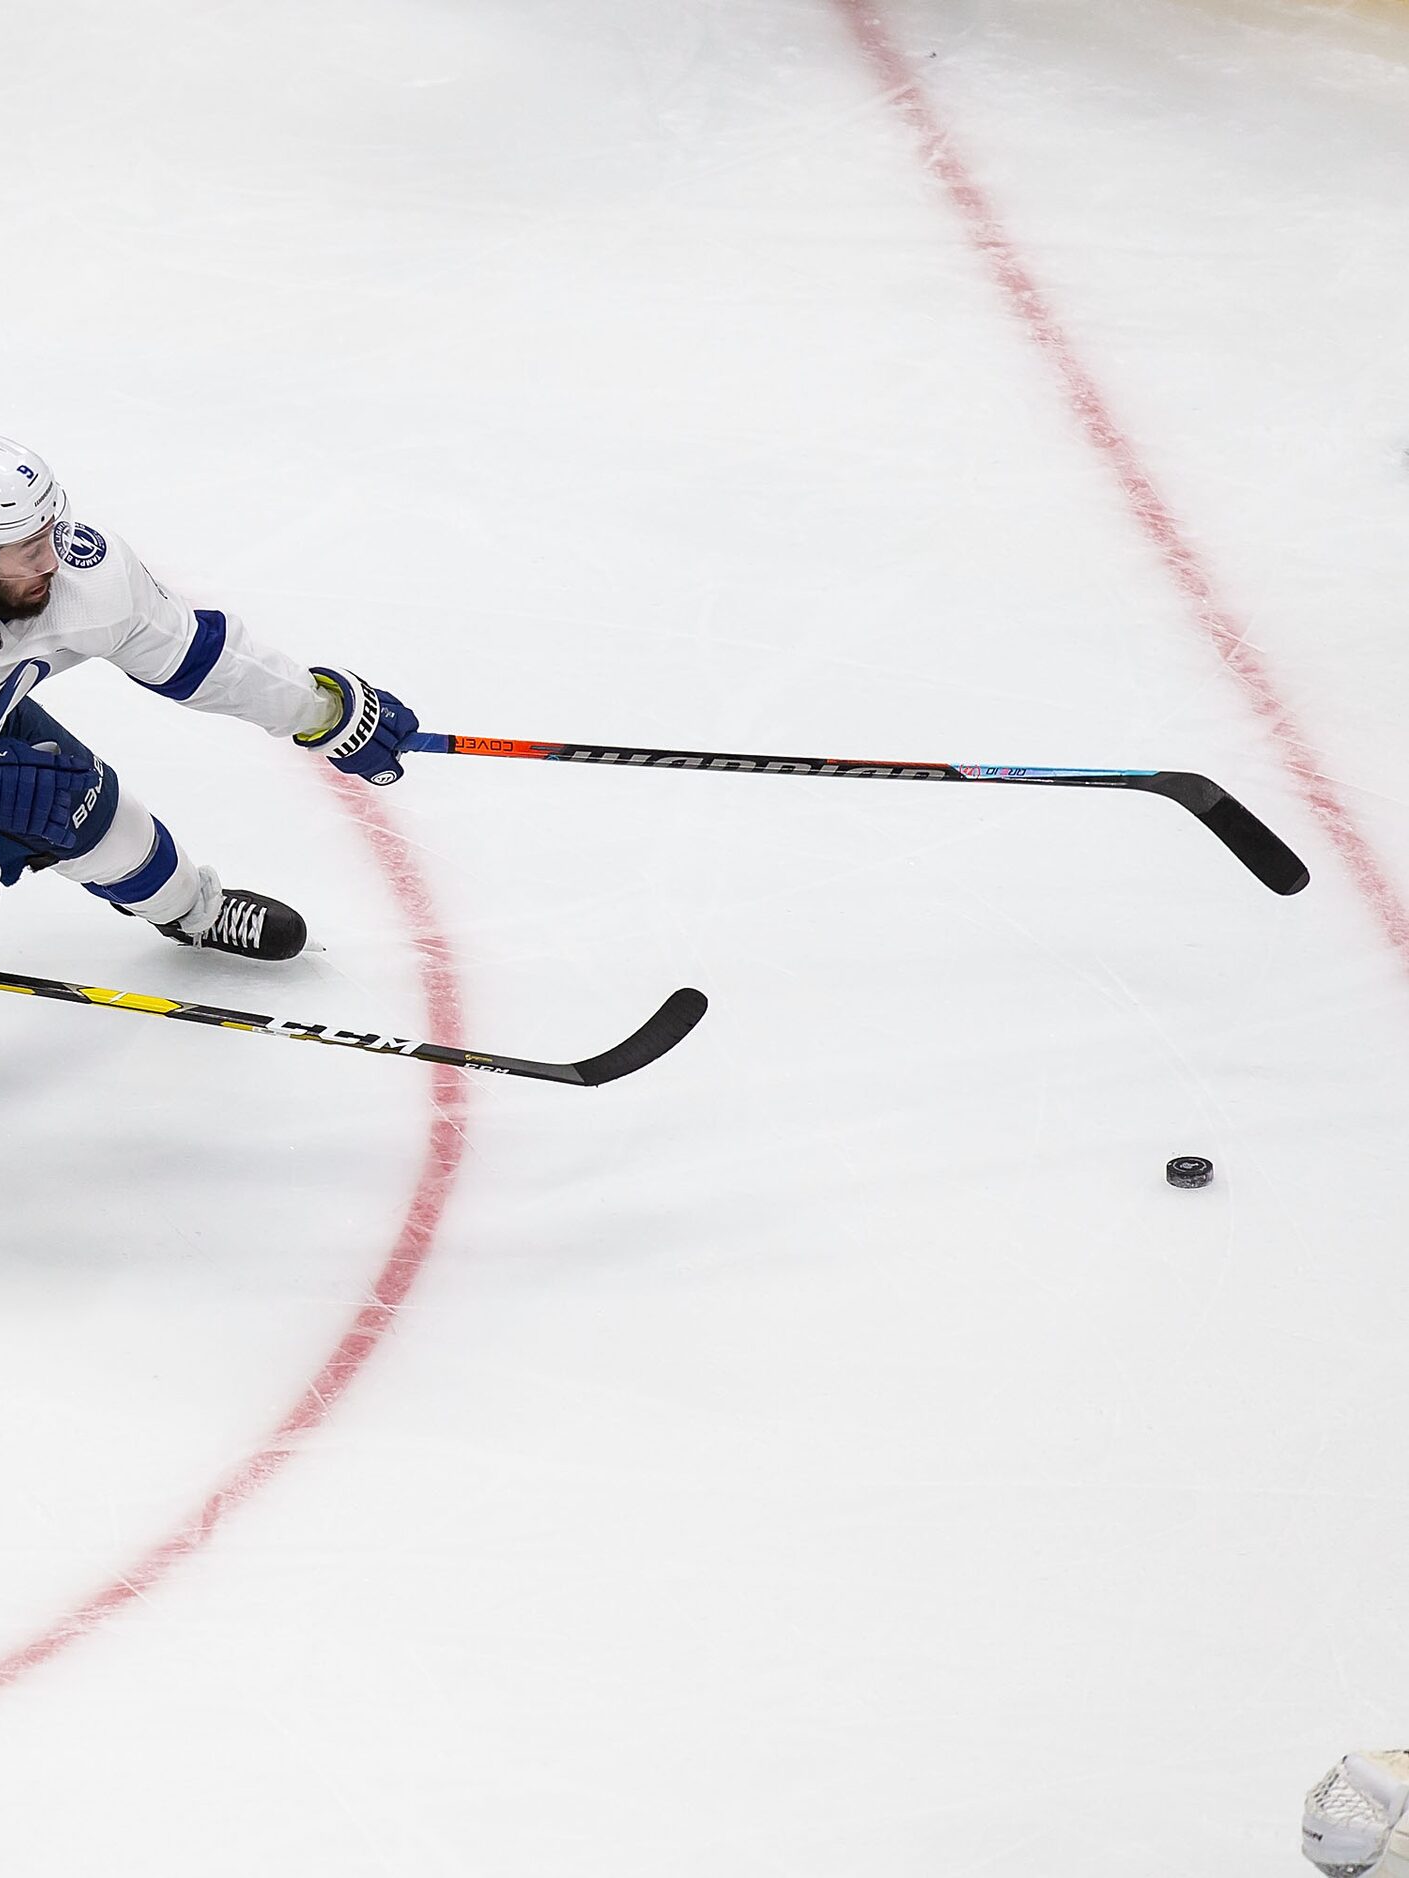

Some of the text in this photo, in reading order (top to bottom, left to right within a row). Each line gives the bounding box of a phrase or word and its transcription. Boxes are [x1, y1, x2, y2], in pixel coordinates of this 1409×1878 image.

[16, 465, 34, 480] 9
[74, 553, 101, 568] TAMPA
[265, 1017, 425, 1055] CCM
